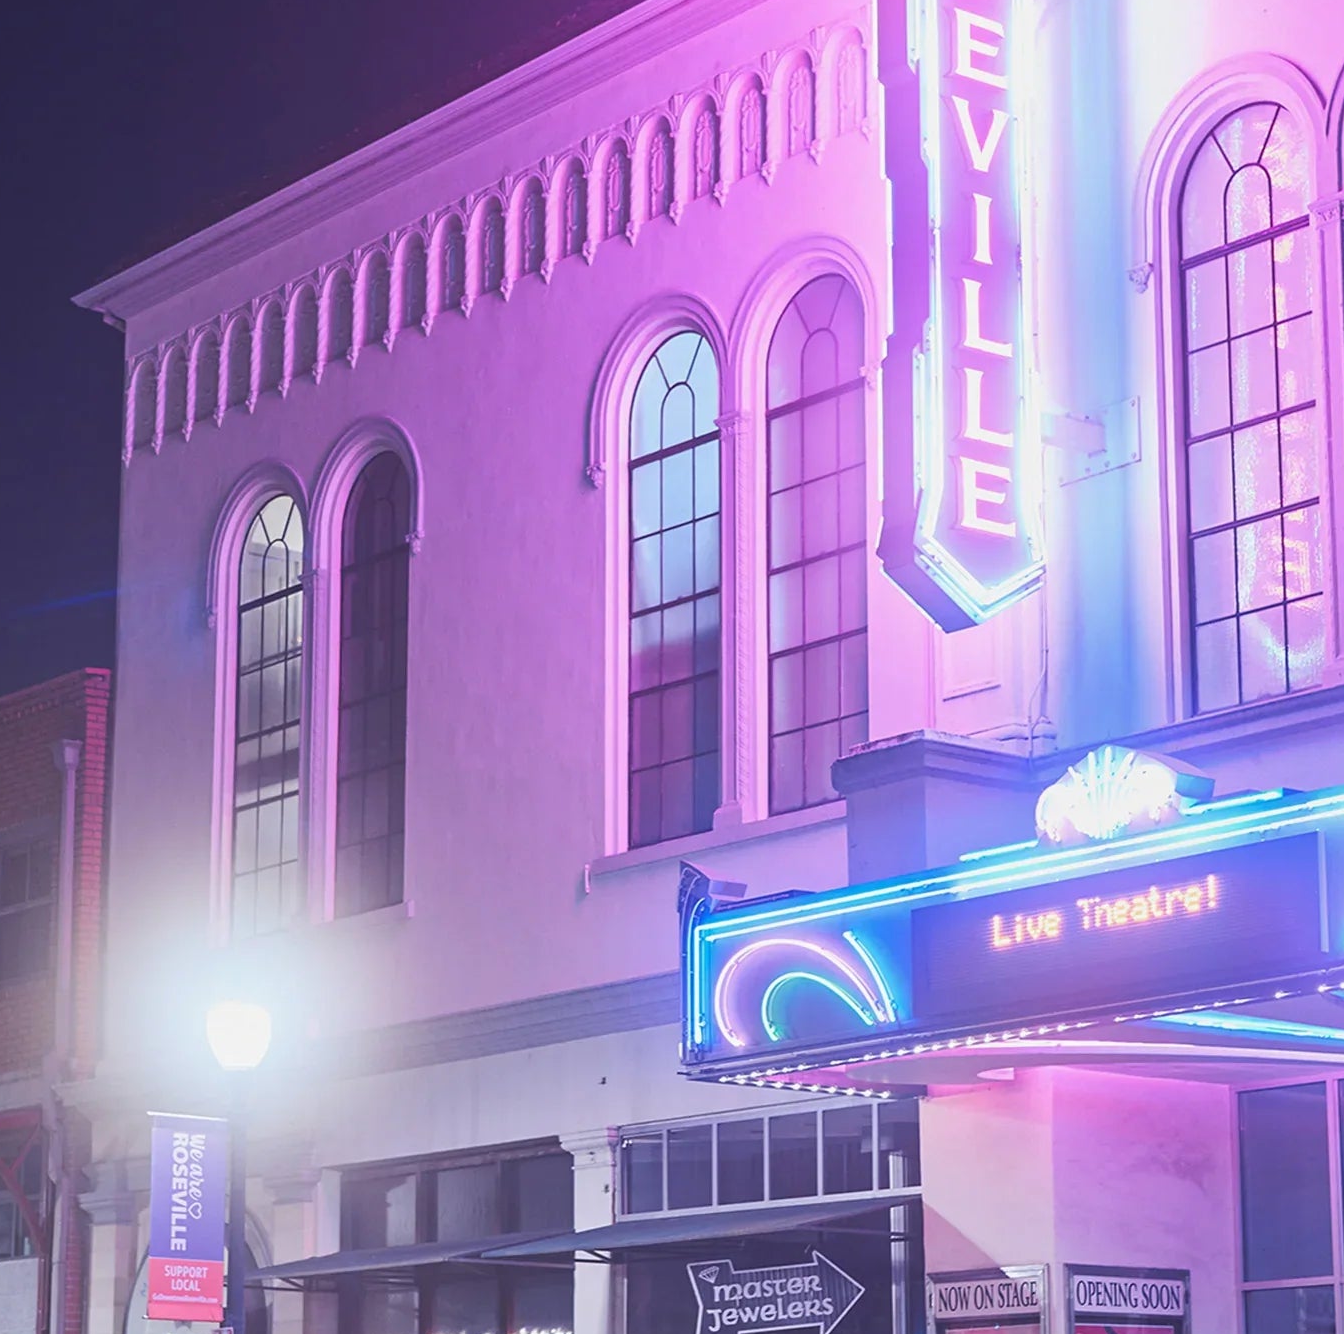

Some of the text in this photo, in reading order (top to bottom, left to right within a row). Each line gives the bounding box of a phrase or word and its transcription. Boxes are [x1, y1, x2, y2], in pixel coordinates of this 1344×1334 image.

[992, 914, 1062, 948] Live
[188, 1134, 206, 1202] We are
[170, 1132, 190, 1251] ROSEVILLE
[164, 1265, 209, 1279] SUPPORT
[171, 1279, 201, 1292] LOCAL
[938, 1281, 1039, 1312] NOW ON STAGE
[1076, 1280, 1182, 1310] OPENING SOON
